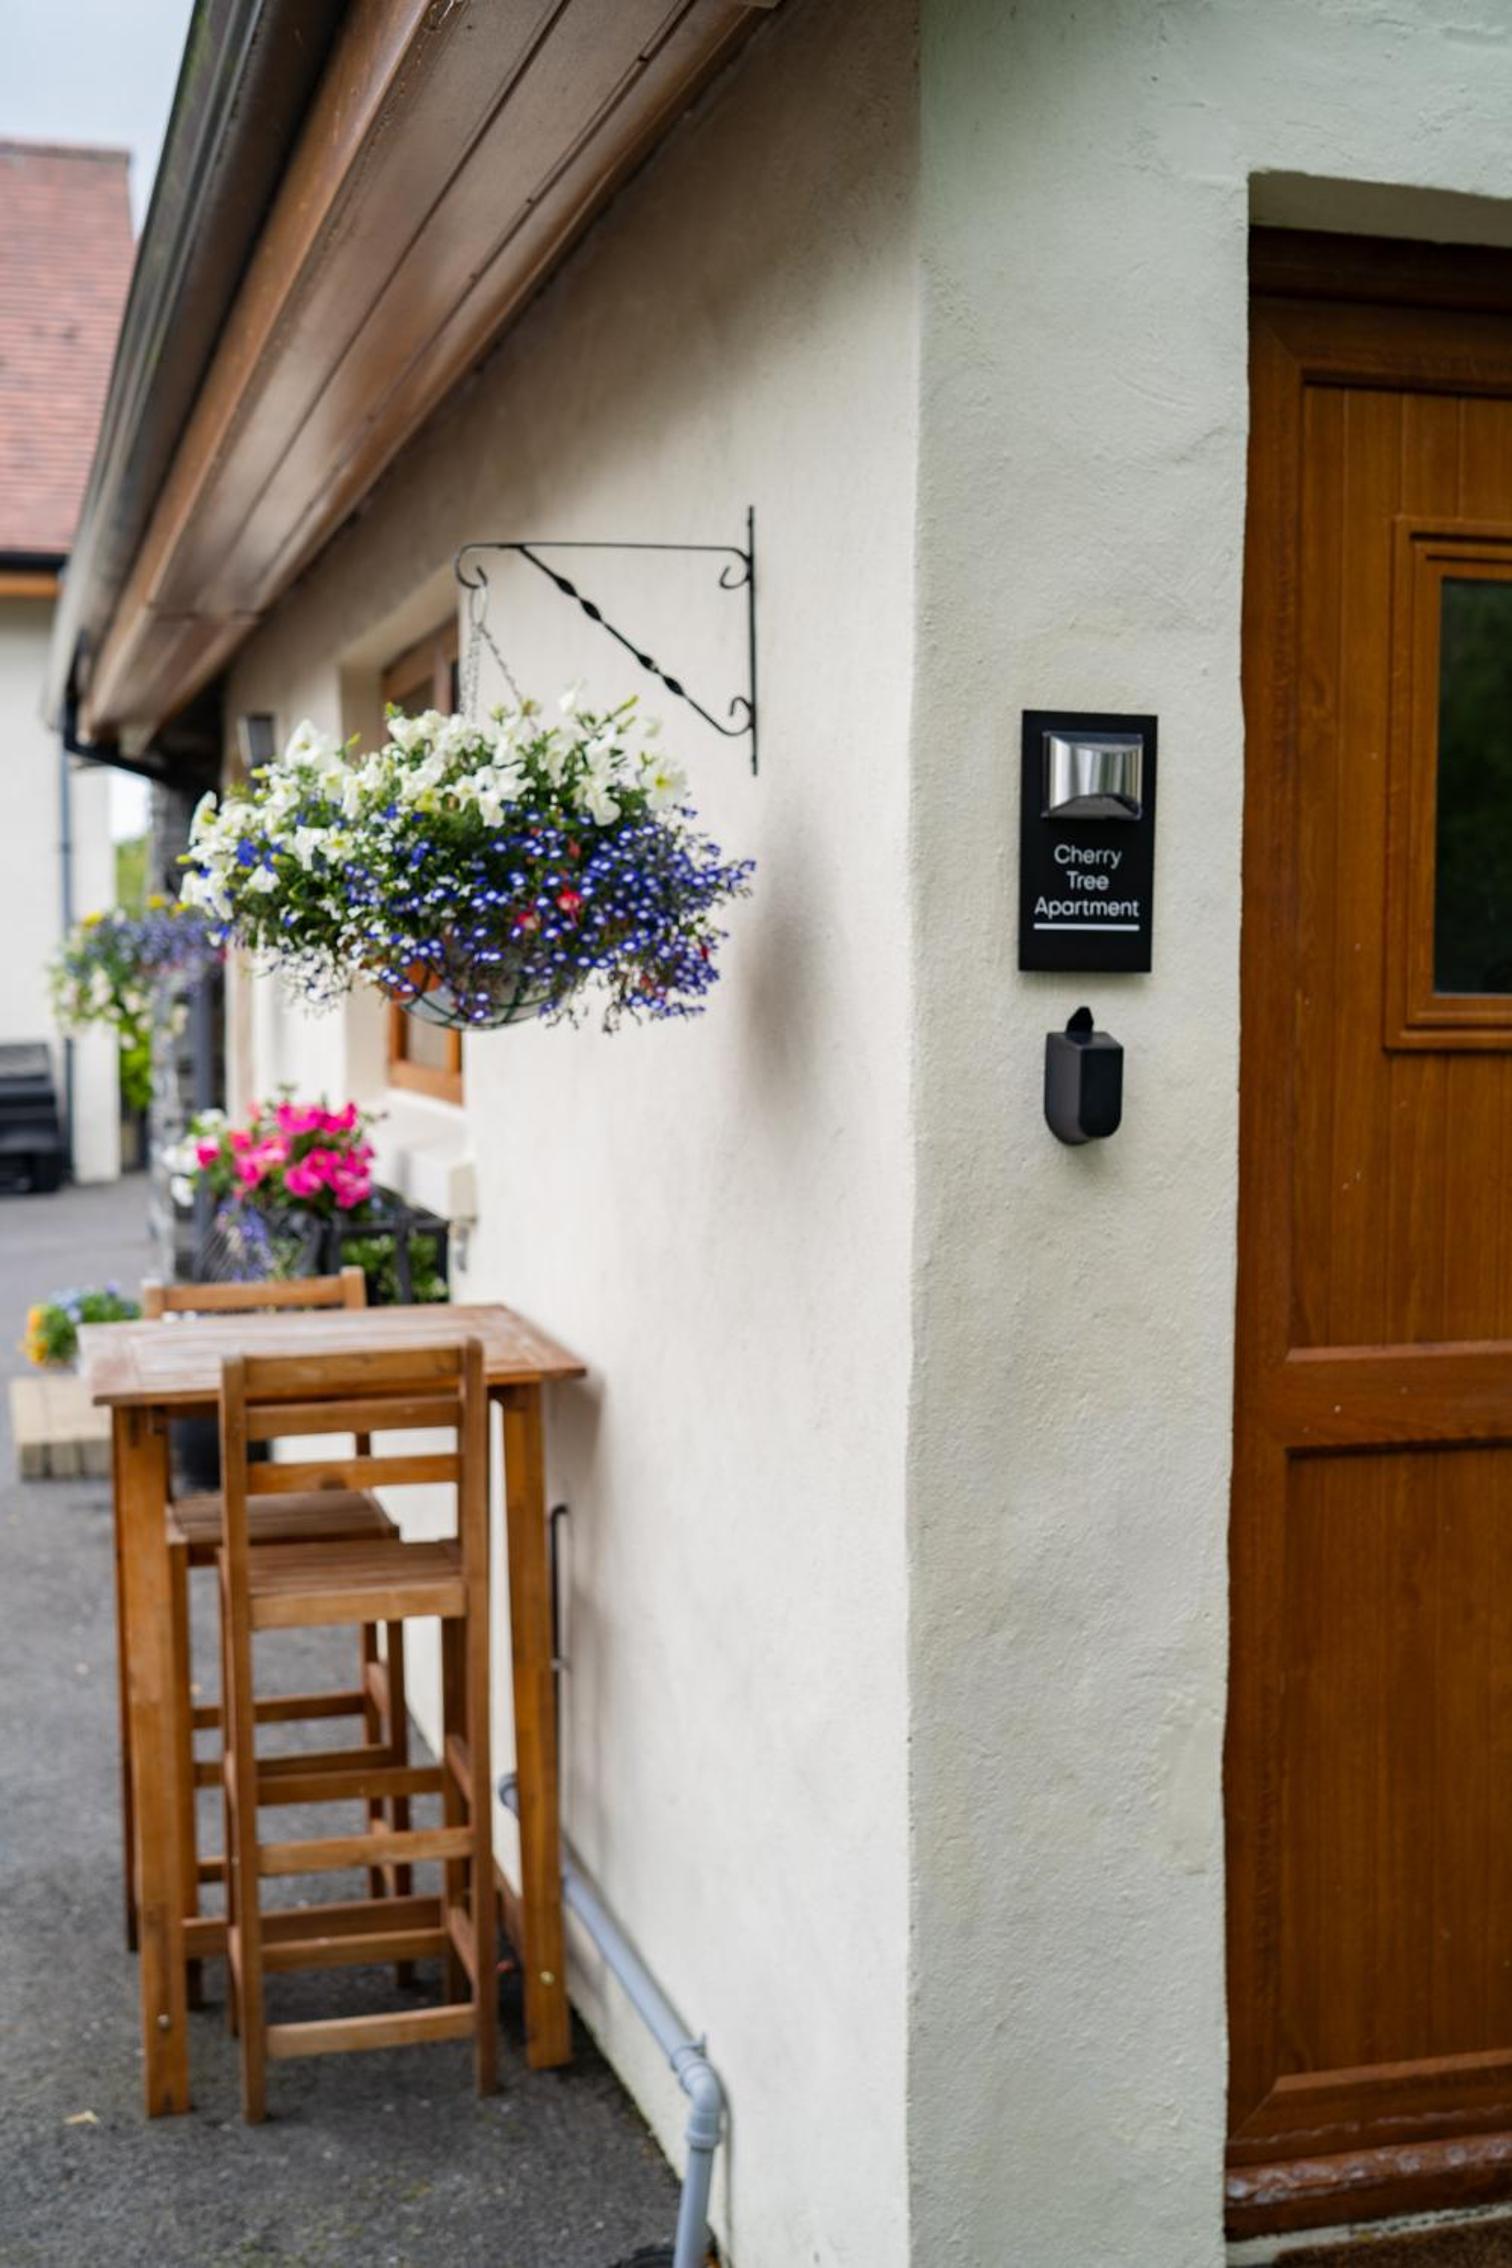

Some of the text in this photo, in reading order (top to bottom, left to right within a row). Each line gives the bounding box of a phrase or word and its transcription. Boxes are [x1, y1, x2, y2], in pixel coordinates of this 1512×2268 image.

[1054, 844, 1122, 869] Cherry
[1067, 871, 1109, 890] Tree
[1034, 896, 1140, 919] Apartment
